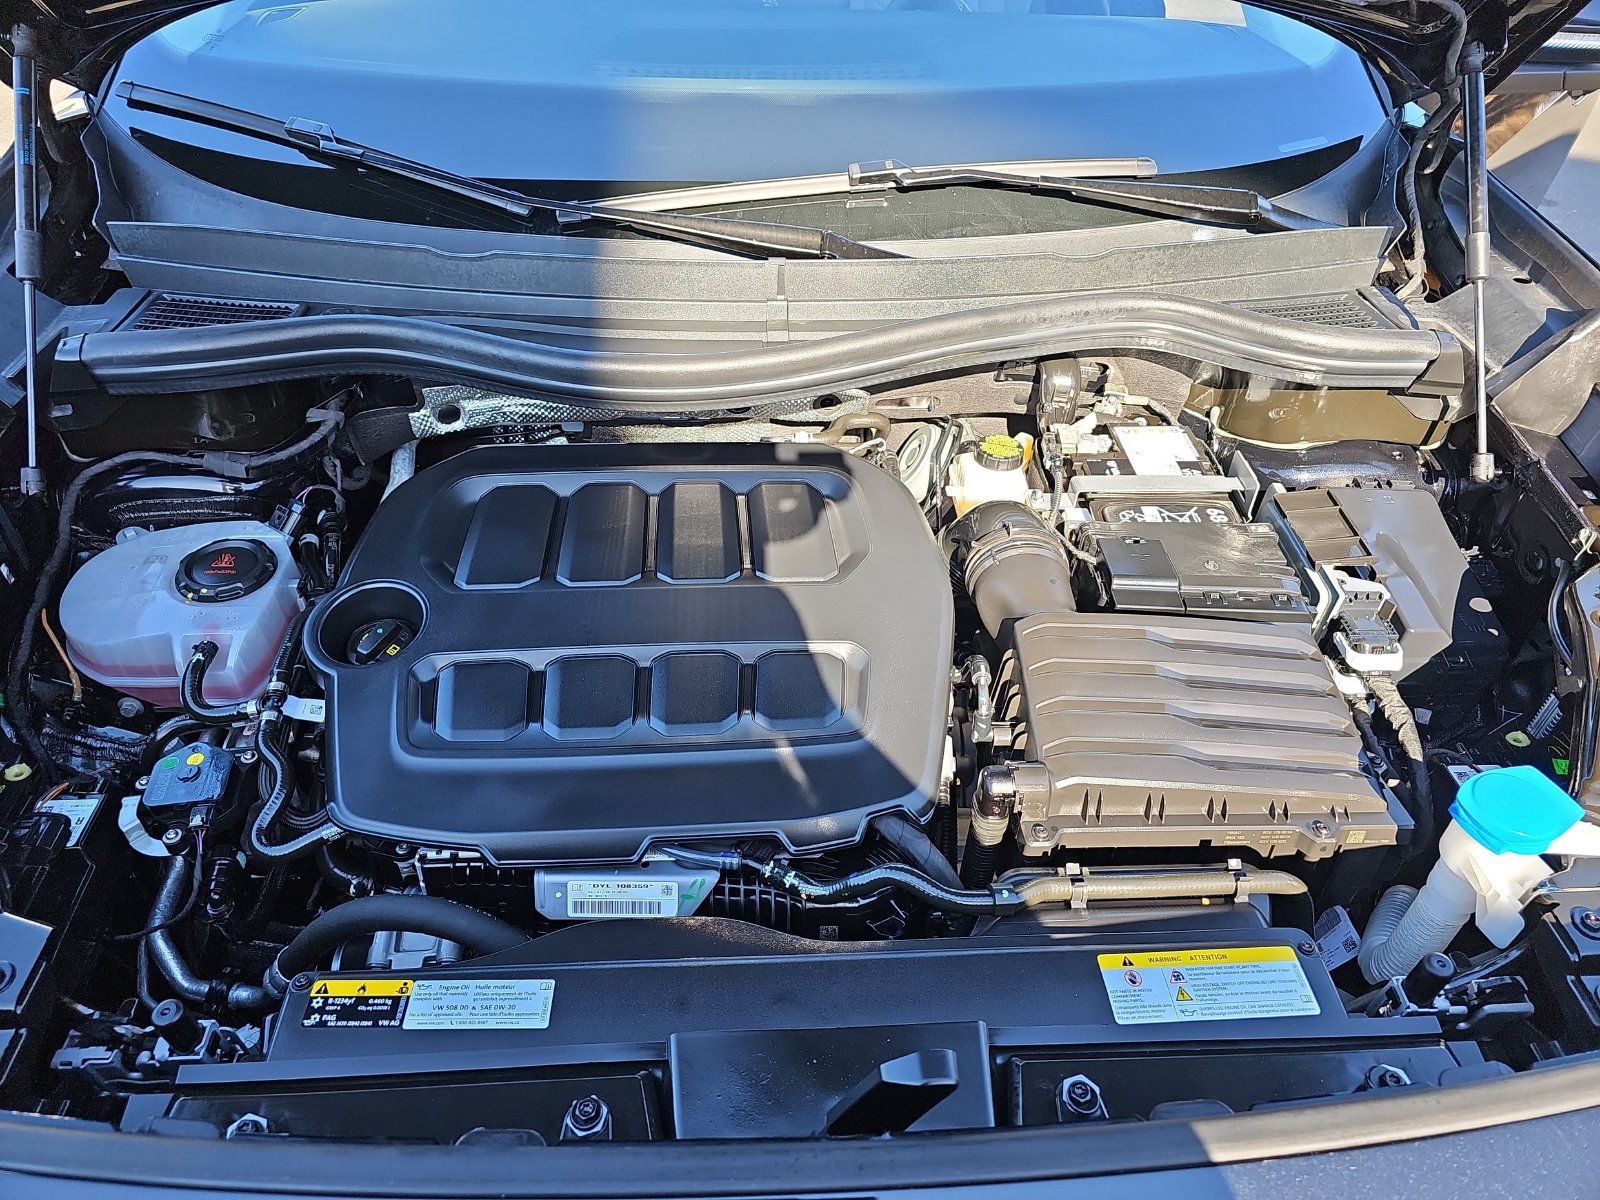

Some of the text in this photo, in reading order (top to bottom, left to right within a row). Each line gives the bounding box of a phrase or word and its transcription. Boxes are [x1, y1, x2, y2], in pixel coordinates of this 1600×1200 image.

[1147, 953, 1228, 963] WARNING ATTENTION
[438, 984, 460, 992] Engine
[327, 997, 356, 1006] R-1234yf
